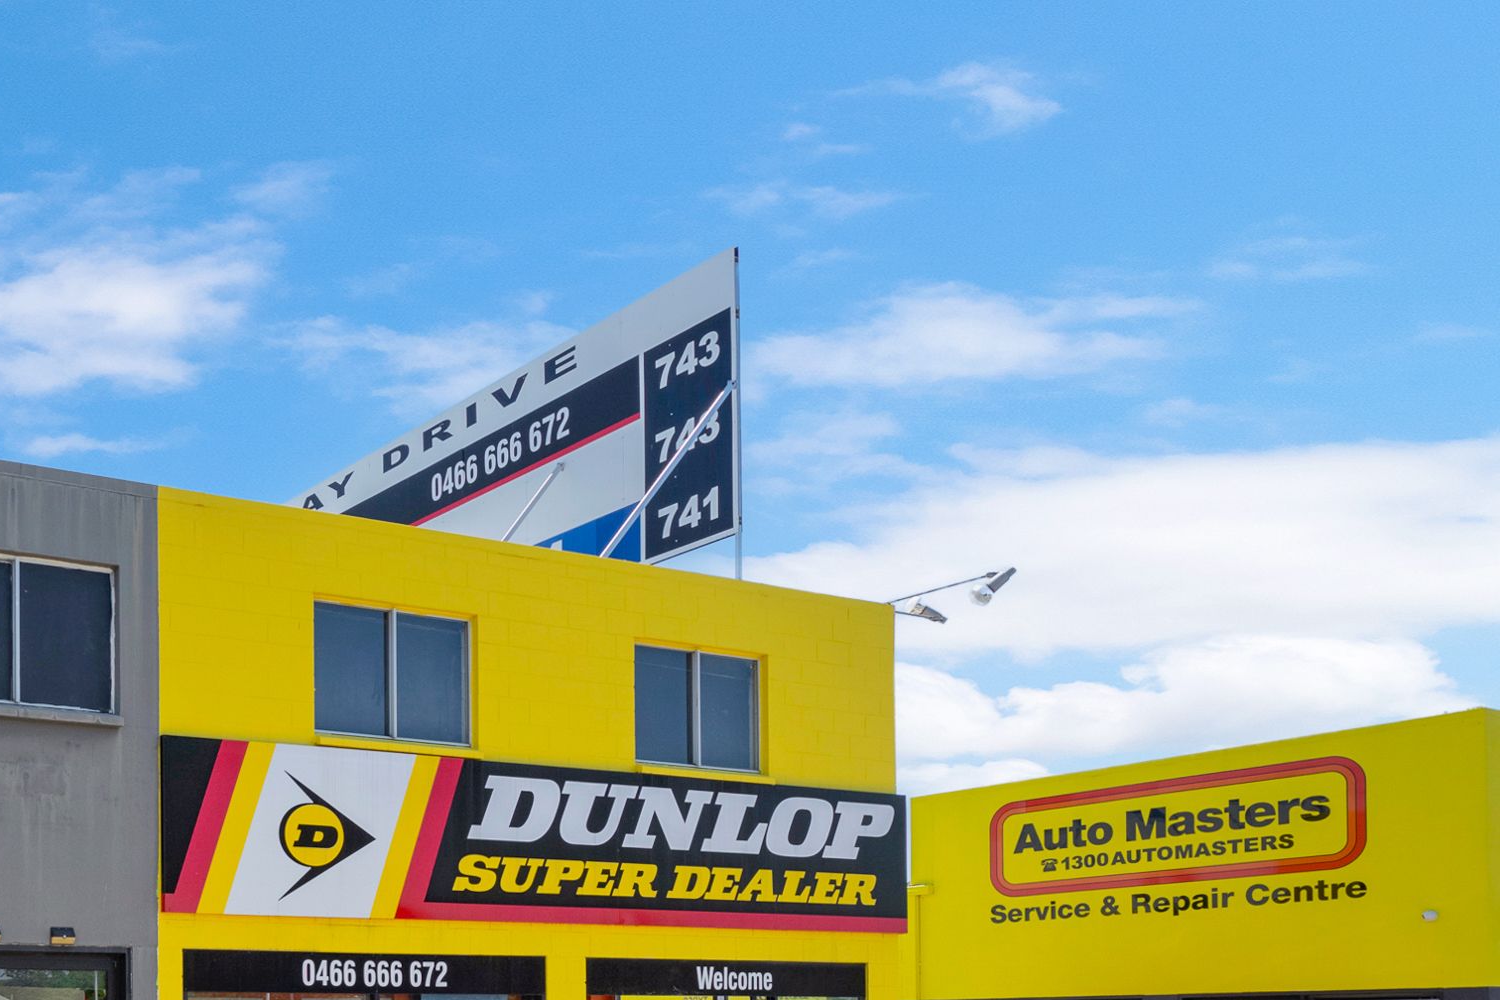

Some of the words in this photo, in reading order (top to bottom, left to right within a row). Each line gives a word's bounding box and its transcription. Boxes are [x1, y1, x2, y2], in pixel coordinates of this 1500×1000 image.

[654, 330, 721, 391] 743
[382, 345, 578, 473] DRIVE
[654, 409, 721, 464] 743
[431, 452, 478, 502] 0466
[484, 434, 522, 477] 666
[528, 406, 571, 453] 672
[657, 485, 721, 539] 741
[466, 773, 896, 862] DUNLOP
[1013, 818, 1114, 854] Auto
[1125, 794, 1332, 843] Masters
[452, 853, 658, 898] SUPER
[666, 864, 878, 907] DEALER
[990, 901, 1091, 924] Service
[1099, 895, 1122, 917] &
[1131, 886, 1235, 916] Repair
[1245, 880, 1368, 907] Centre
[301, 958, 357, 988] 0466
[363, 959, 404, 988] 666
[409, 960, 449, 988] 672
[696, 965, 774, 991] Welcome
